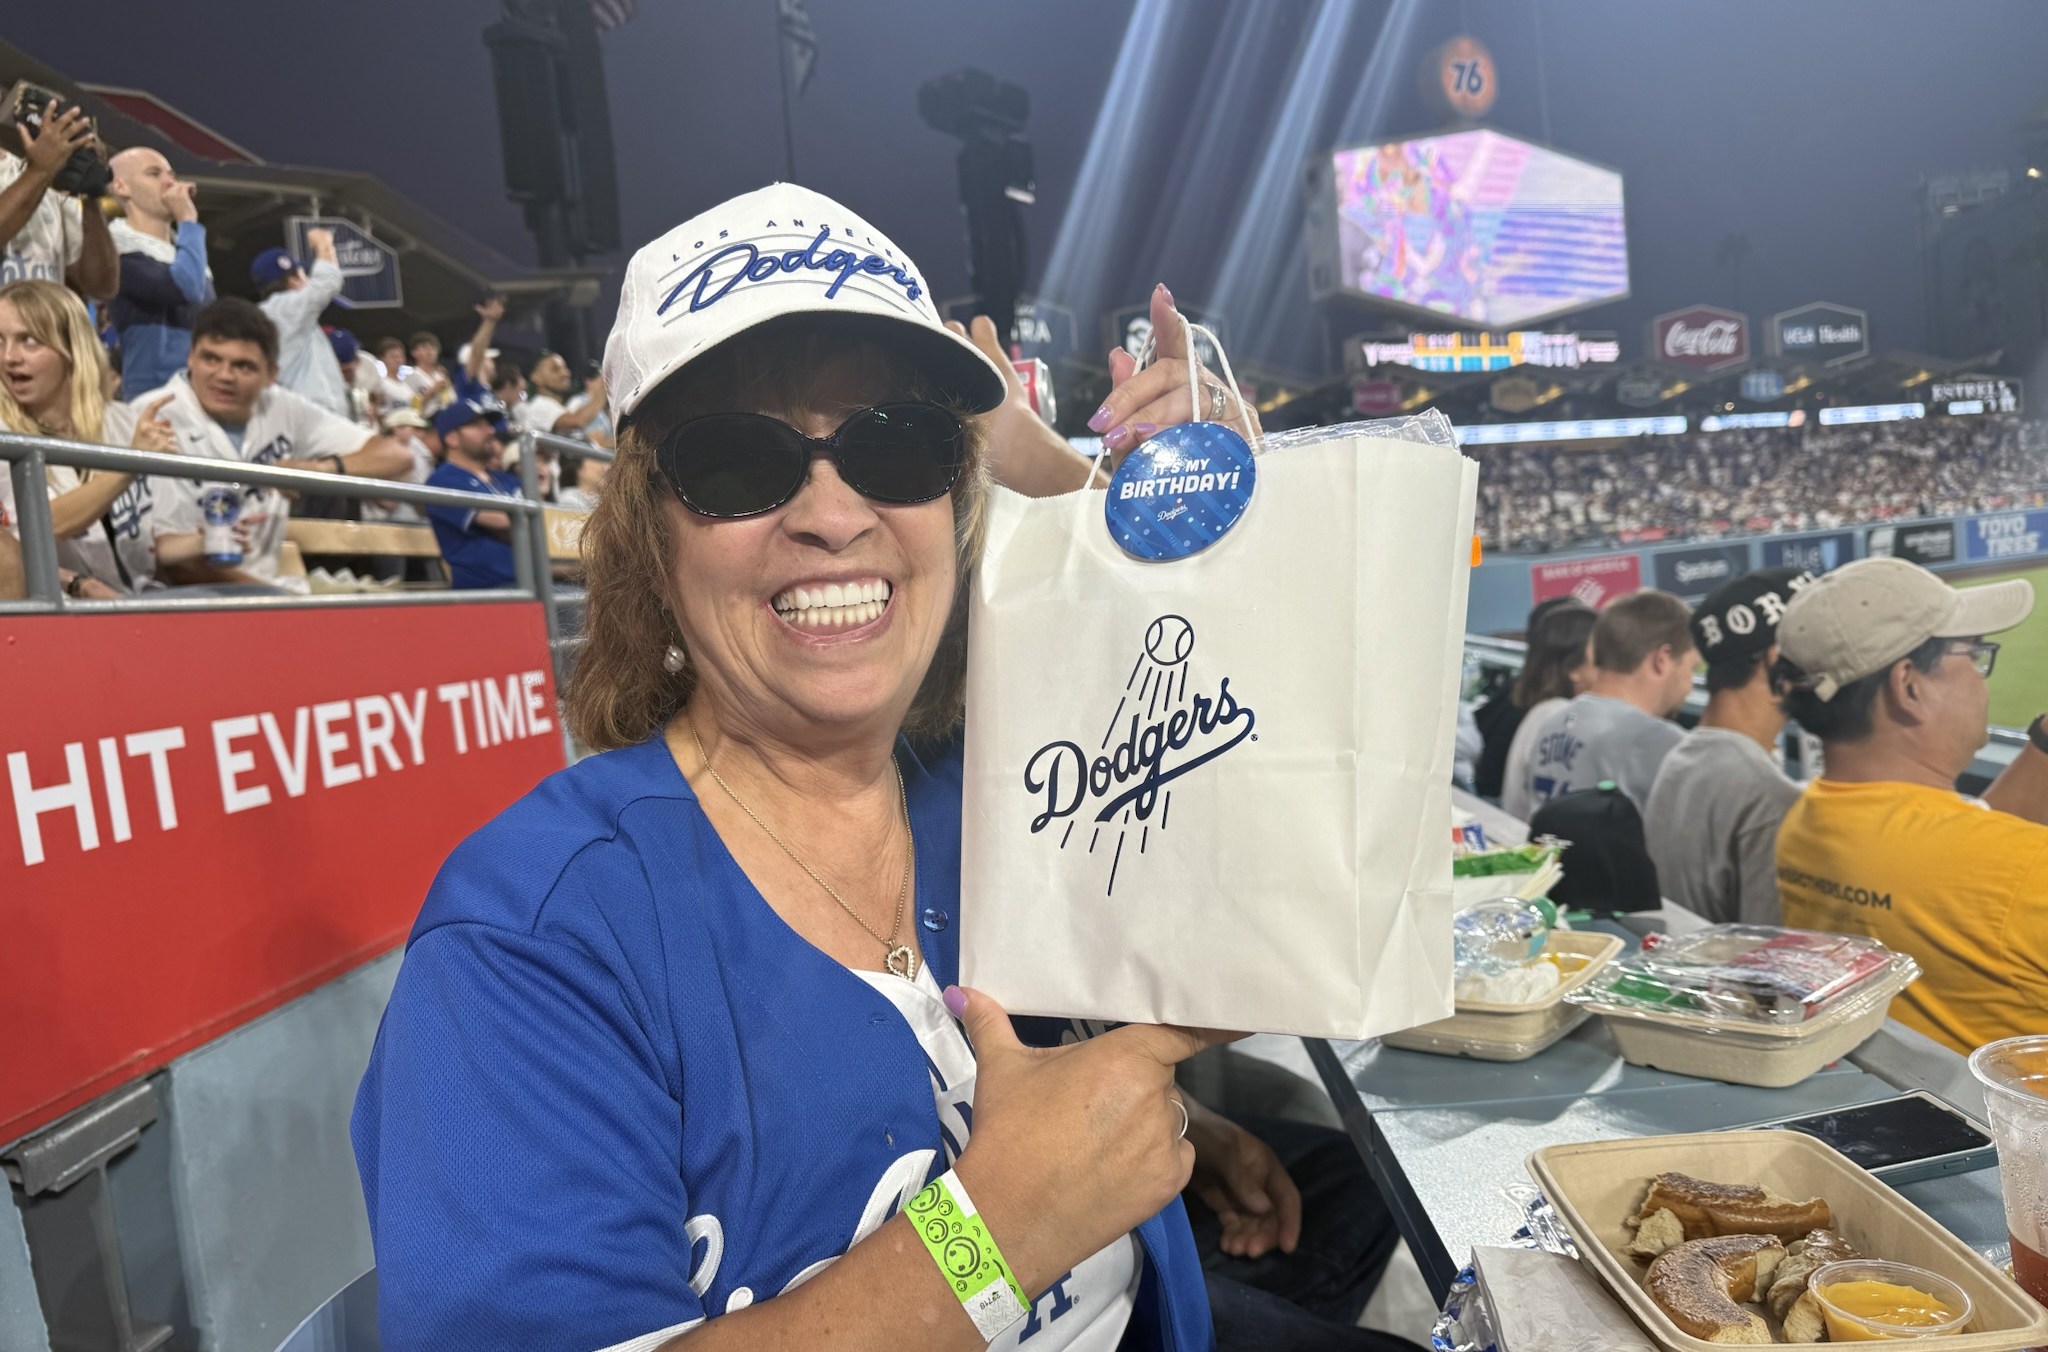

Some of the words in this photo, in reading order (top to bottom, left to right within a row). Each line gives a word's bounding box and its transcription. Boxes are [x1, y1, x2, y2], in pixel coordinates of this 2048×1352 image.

[1451, 60, 1482, 93] 76
[673, 229, 729, 262] LOS
[657, 229, 923, 315] Dodgers
[1186, 458, 1210, 472] MY
[1120, 472, 1240, 500] BIRTHDAY!
[1978, 514, 2027, 539] TOYO
[1987, 533, 2040, 559] TIRES
[7, 727, 186, 866] HIT
[211, 688, 427, 815] EVERY
[437, 669, 553, 755] TIME
[1024, 677, 1255, 833] Dodgers
